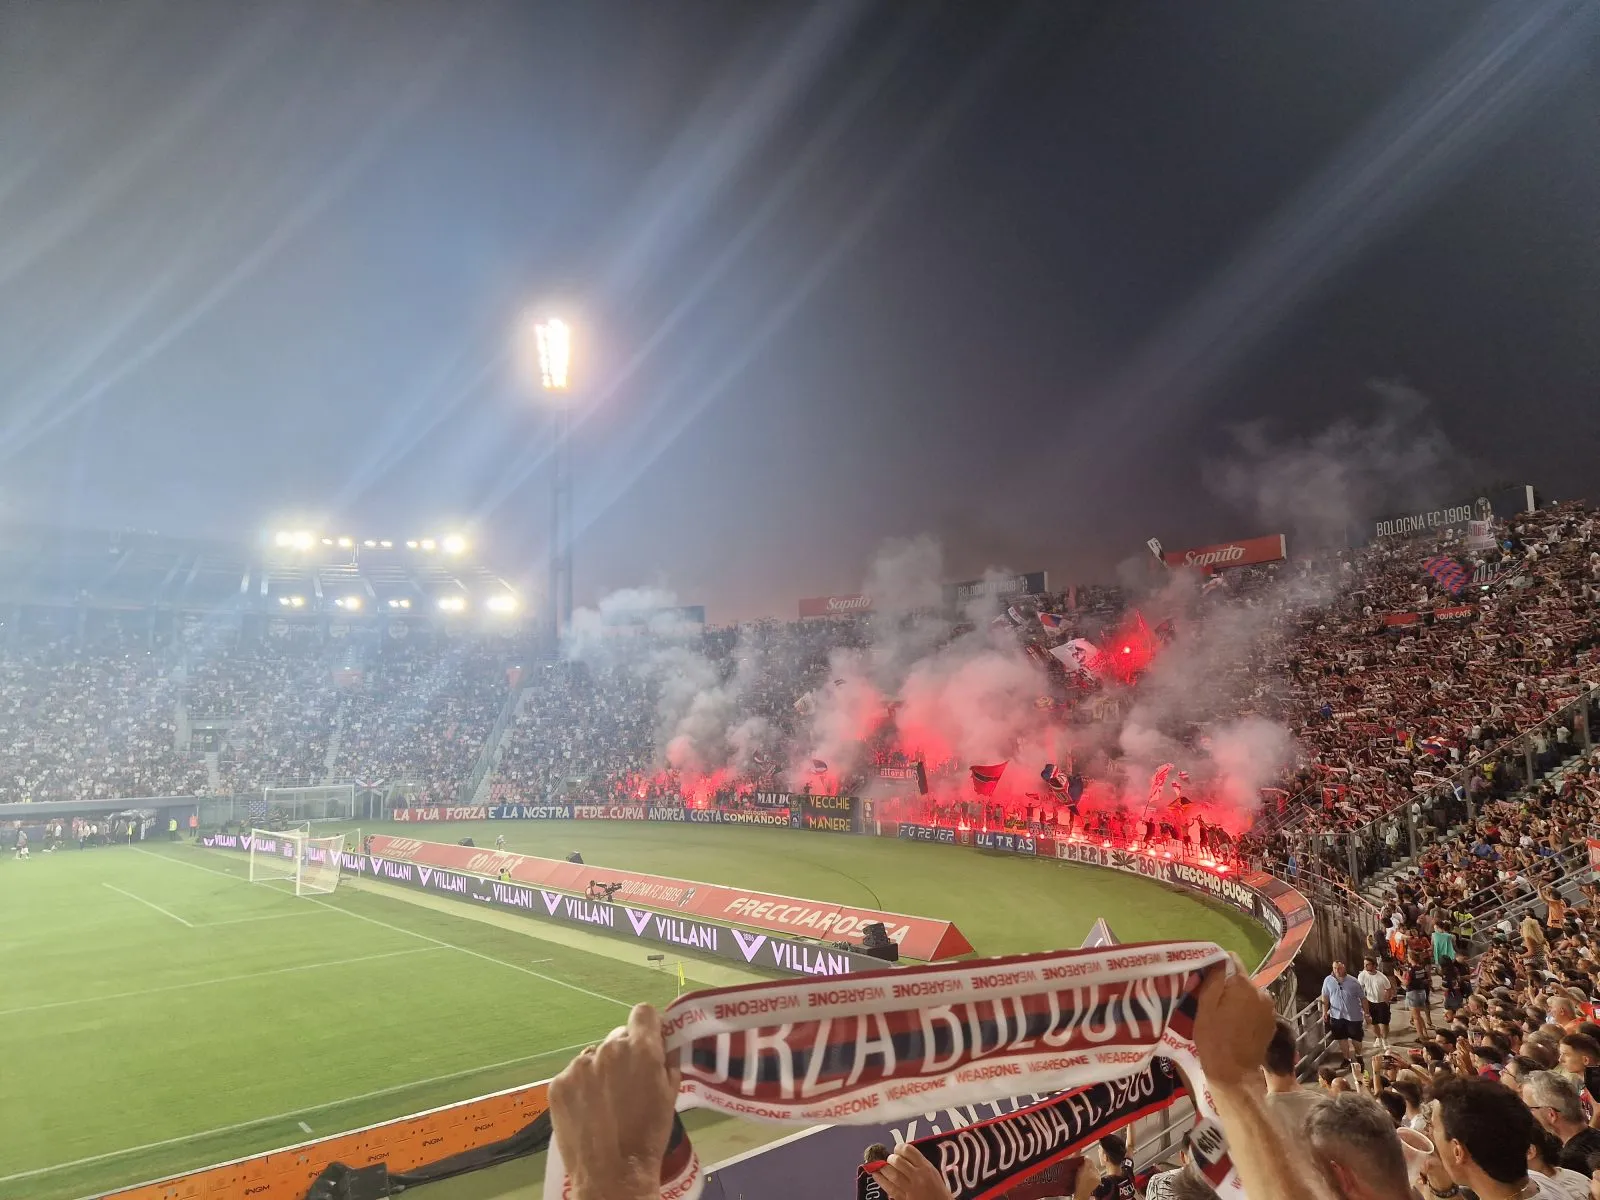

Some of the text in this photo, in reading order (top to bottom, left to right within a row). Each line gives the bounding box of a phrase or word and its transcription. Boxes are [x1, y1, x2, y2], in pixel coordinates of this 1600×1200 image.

[1376, 504, 1471, 537] BOLOGNA FC 1909
[1182, 544, 1246, 568] Saputo
[826, 595, 871, 612] Saputo
[809, 796, 850, 810] VECCHIE
[393, 807, 410, 821] LA
[416, 807, 440, 821] TUA
[446, 806, 486, 820] FORZA
[502, 806, 519, 819] LA
[522, 806, 570, 819] NOSTRA
[648, 807, 685, 821] ANDREA
[690, 810, 722, 823] COSTA
[723, 813, 787, 826] COMMANDOS
[809, 817, 851, 831] MANIERE
[214, 834, 237, 848] VILLANI
[383, 861, 412, 881] VILLANI
[434, 871, 467, 894] VILLANI
[1174, 862, 1254, 910] VECCHIO CUORE
[493, 883, 532, 908] VILLANI
[565, 898, 614, 927] VILLANI
[656, 916, 717, 950] VILLANI
[771, 940, 850, 976] VILLANI
[1106, 952, 1162, 970] WEAREONE
[971, 969, 1038, 989] WEAREONE
[1042, 960, 1102, 980] WEAREONE
[808, 986, 886, 1007] WEAREONE
[892, 978, 963, 998] WEAREONE
[714, 994, 801, 1020] WEAREONE
[680, 972, 1166, 1100] ORZA BOLOGN
[937, 1104, 1069, 1200] BOLOGNA
[1067, 1093, 1104, 1134] FC
